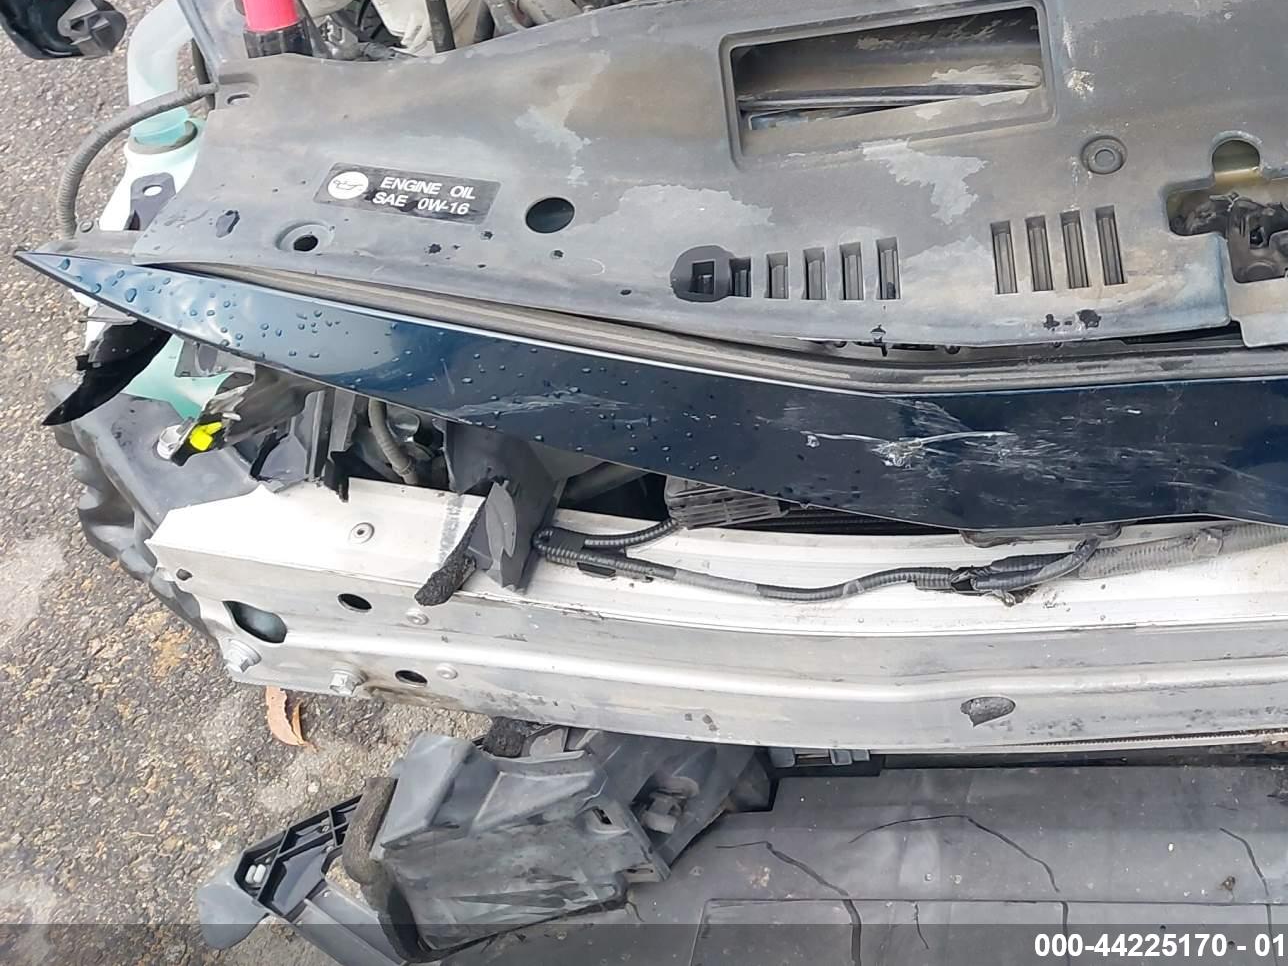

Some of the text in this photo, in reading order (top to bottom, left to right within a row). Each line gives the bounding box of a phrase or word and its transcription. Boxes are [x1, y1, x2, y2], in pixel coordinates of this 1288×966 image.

[380, 176, 476, 199] ENGINE OIL
[372, 192, 470, 215] SAE 0W-16
